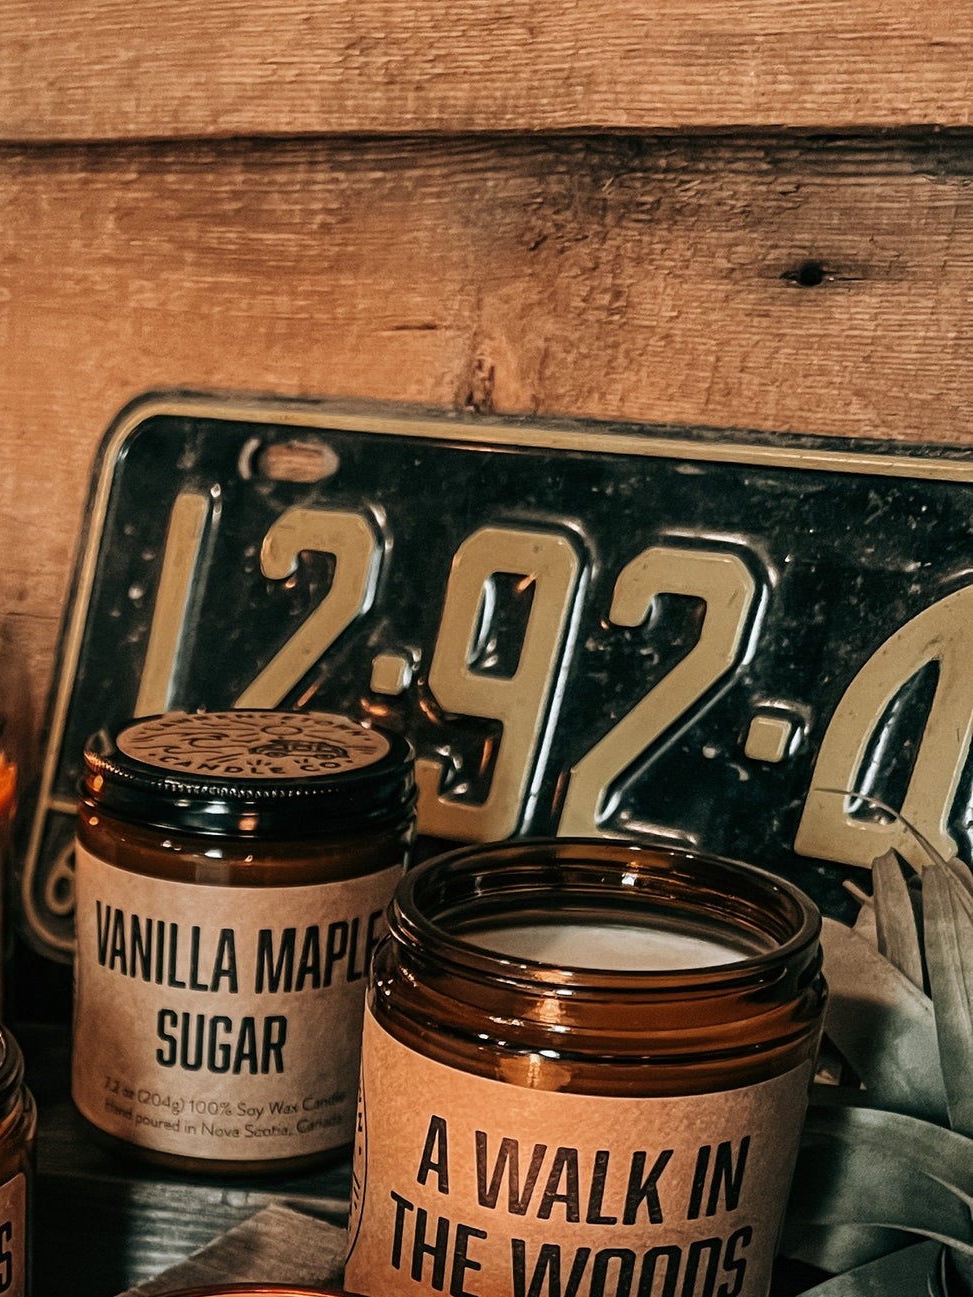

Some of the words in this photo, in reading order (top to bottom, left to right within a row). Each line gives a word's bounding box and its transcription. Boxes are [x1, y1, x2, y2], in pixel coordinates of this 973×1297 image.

[158, 756, 285, 775] CANDLE
[96, 900, 238, 994] VANILLA
[155, 1008, 288, 1075] SUGAR
[135, 1114, 180, 1133] poured
[184, 1120, 197, 1135] in
[201, 1121, 240, 1138] Nova
[137, 1088, 186, 1116] (204g)
[189, 1099, 233, 1117] 100%
[236, 1102, 265, 1122] Soy
[268, 1100, 298, 1116] Wax
[417, 1114, 450, 1195] A
[475, 1130, 674, 1226] WALK
[687, 1135, 751, 1221] IN
